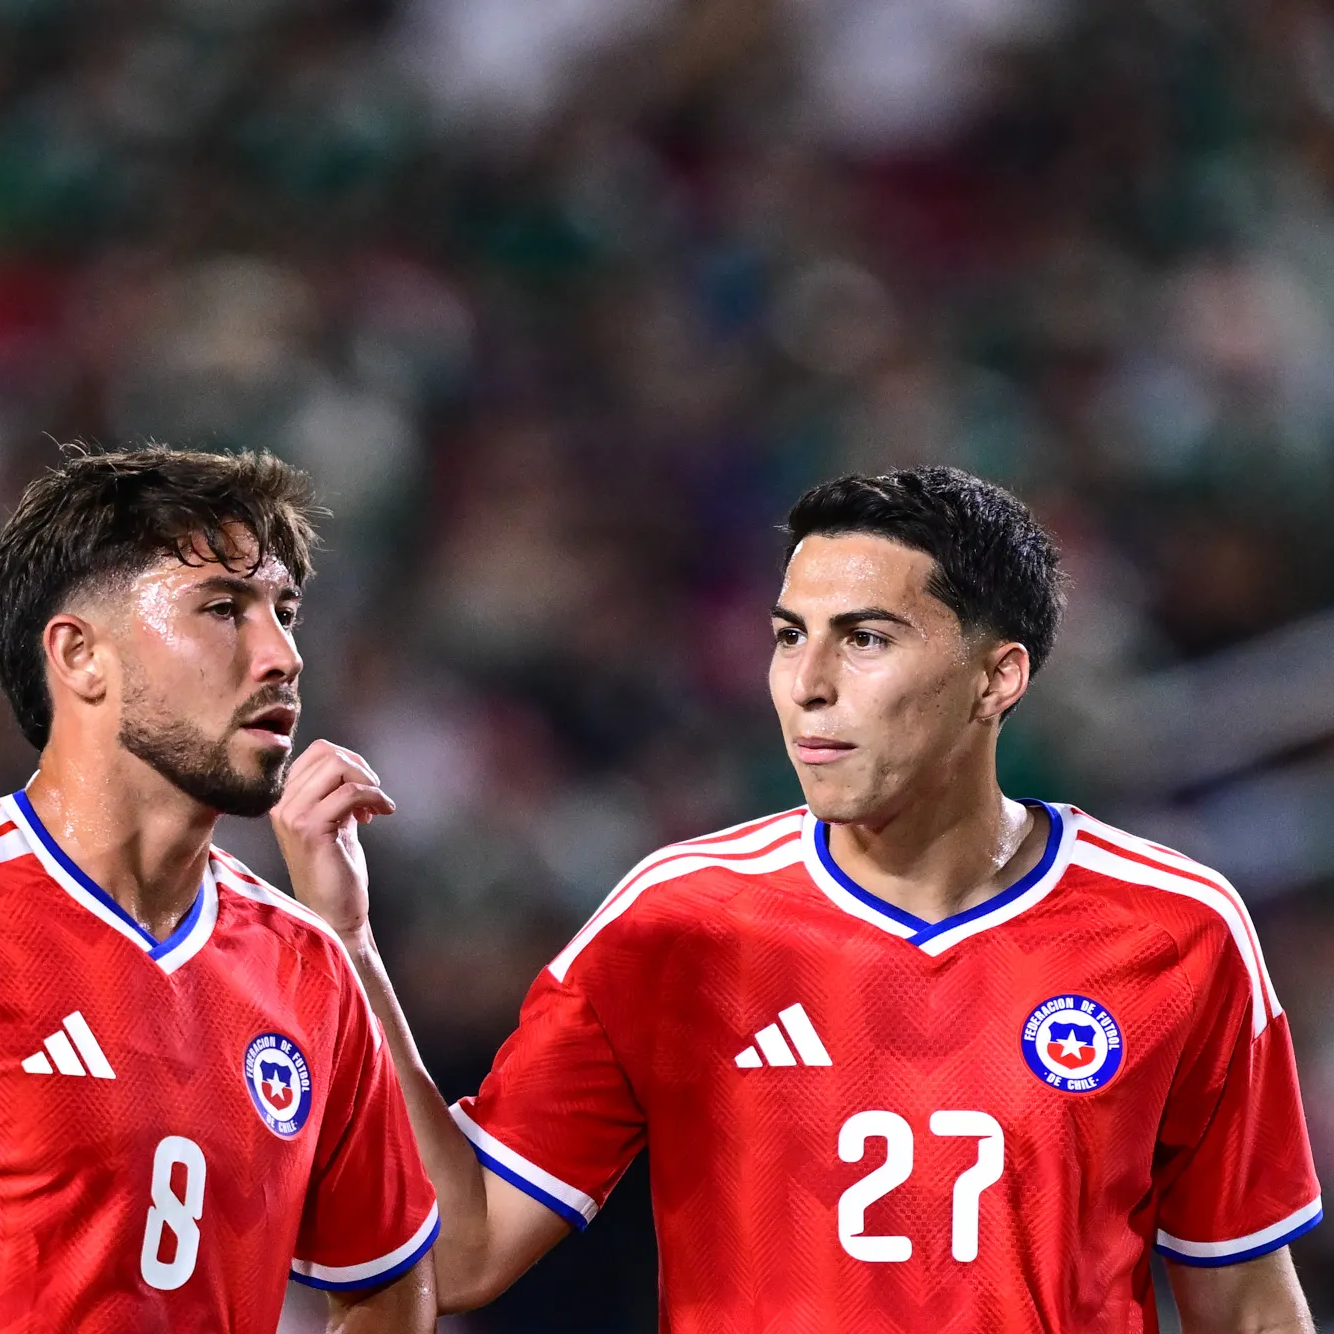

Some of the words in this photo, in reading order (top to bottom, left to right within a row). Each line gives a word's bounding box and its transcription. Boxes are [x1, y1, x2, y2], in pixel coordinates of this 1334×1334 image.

[1024, 997, 1074, 1041] FEDERACION
[1081, 1000, 1096, 1014] DE
[1096, 1011, 1120, 1050] FUTBOL
[246, 1036, 276, 1079] FEDERACION
[280, 1039, 292, 1054] DE
[292, 1052, 310, 1092] FUTBOL
[1046, 1073, 1062, 1087] DE
[1067, 1077, 1097, 1090] CHILE
[266, 1113, 275, 1128] DE
[278, 1120, 297, 1133] CHILE
[140, 1135, 206, 1290] 8
[838, 1110, 1005, 1263] 27
